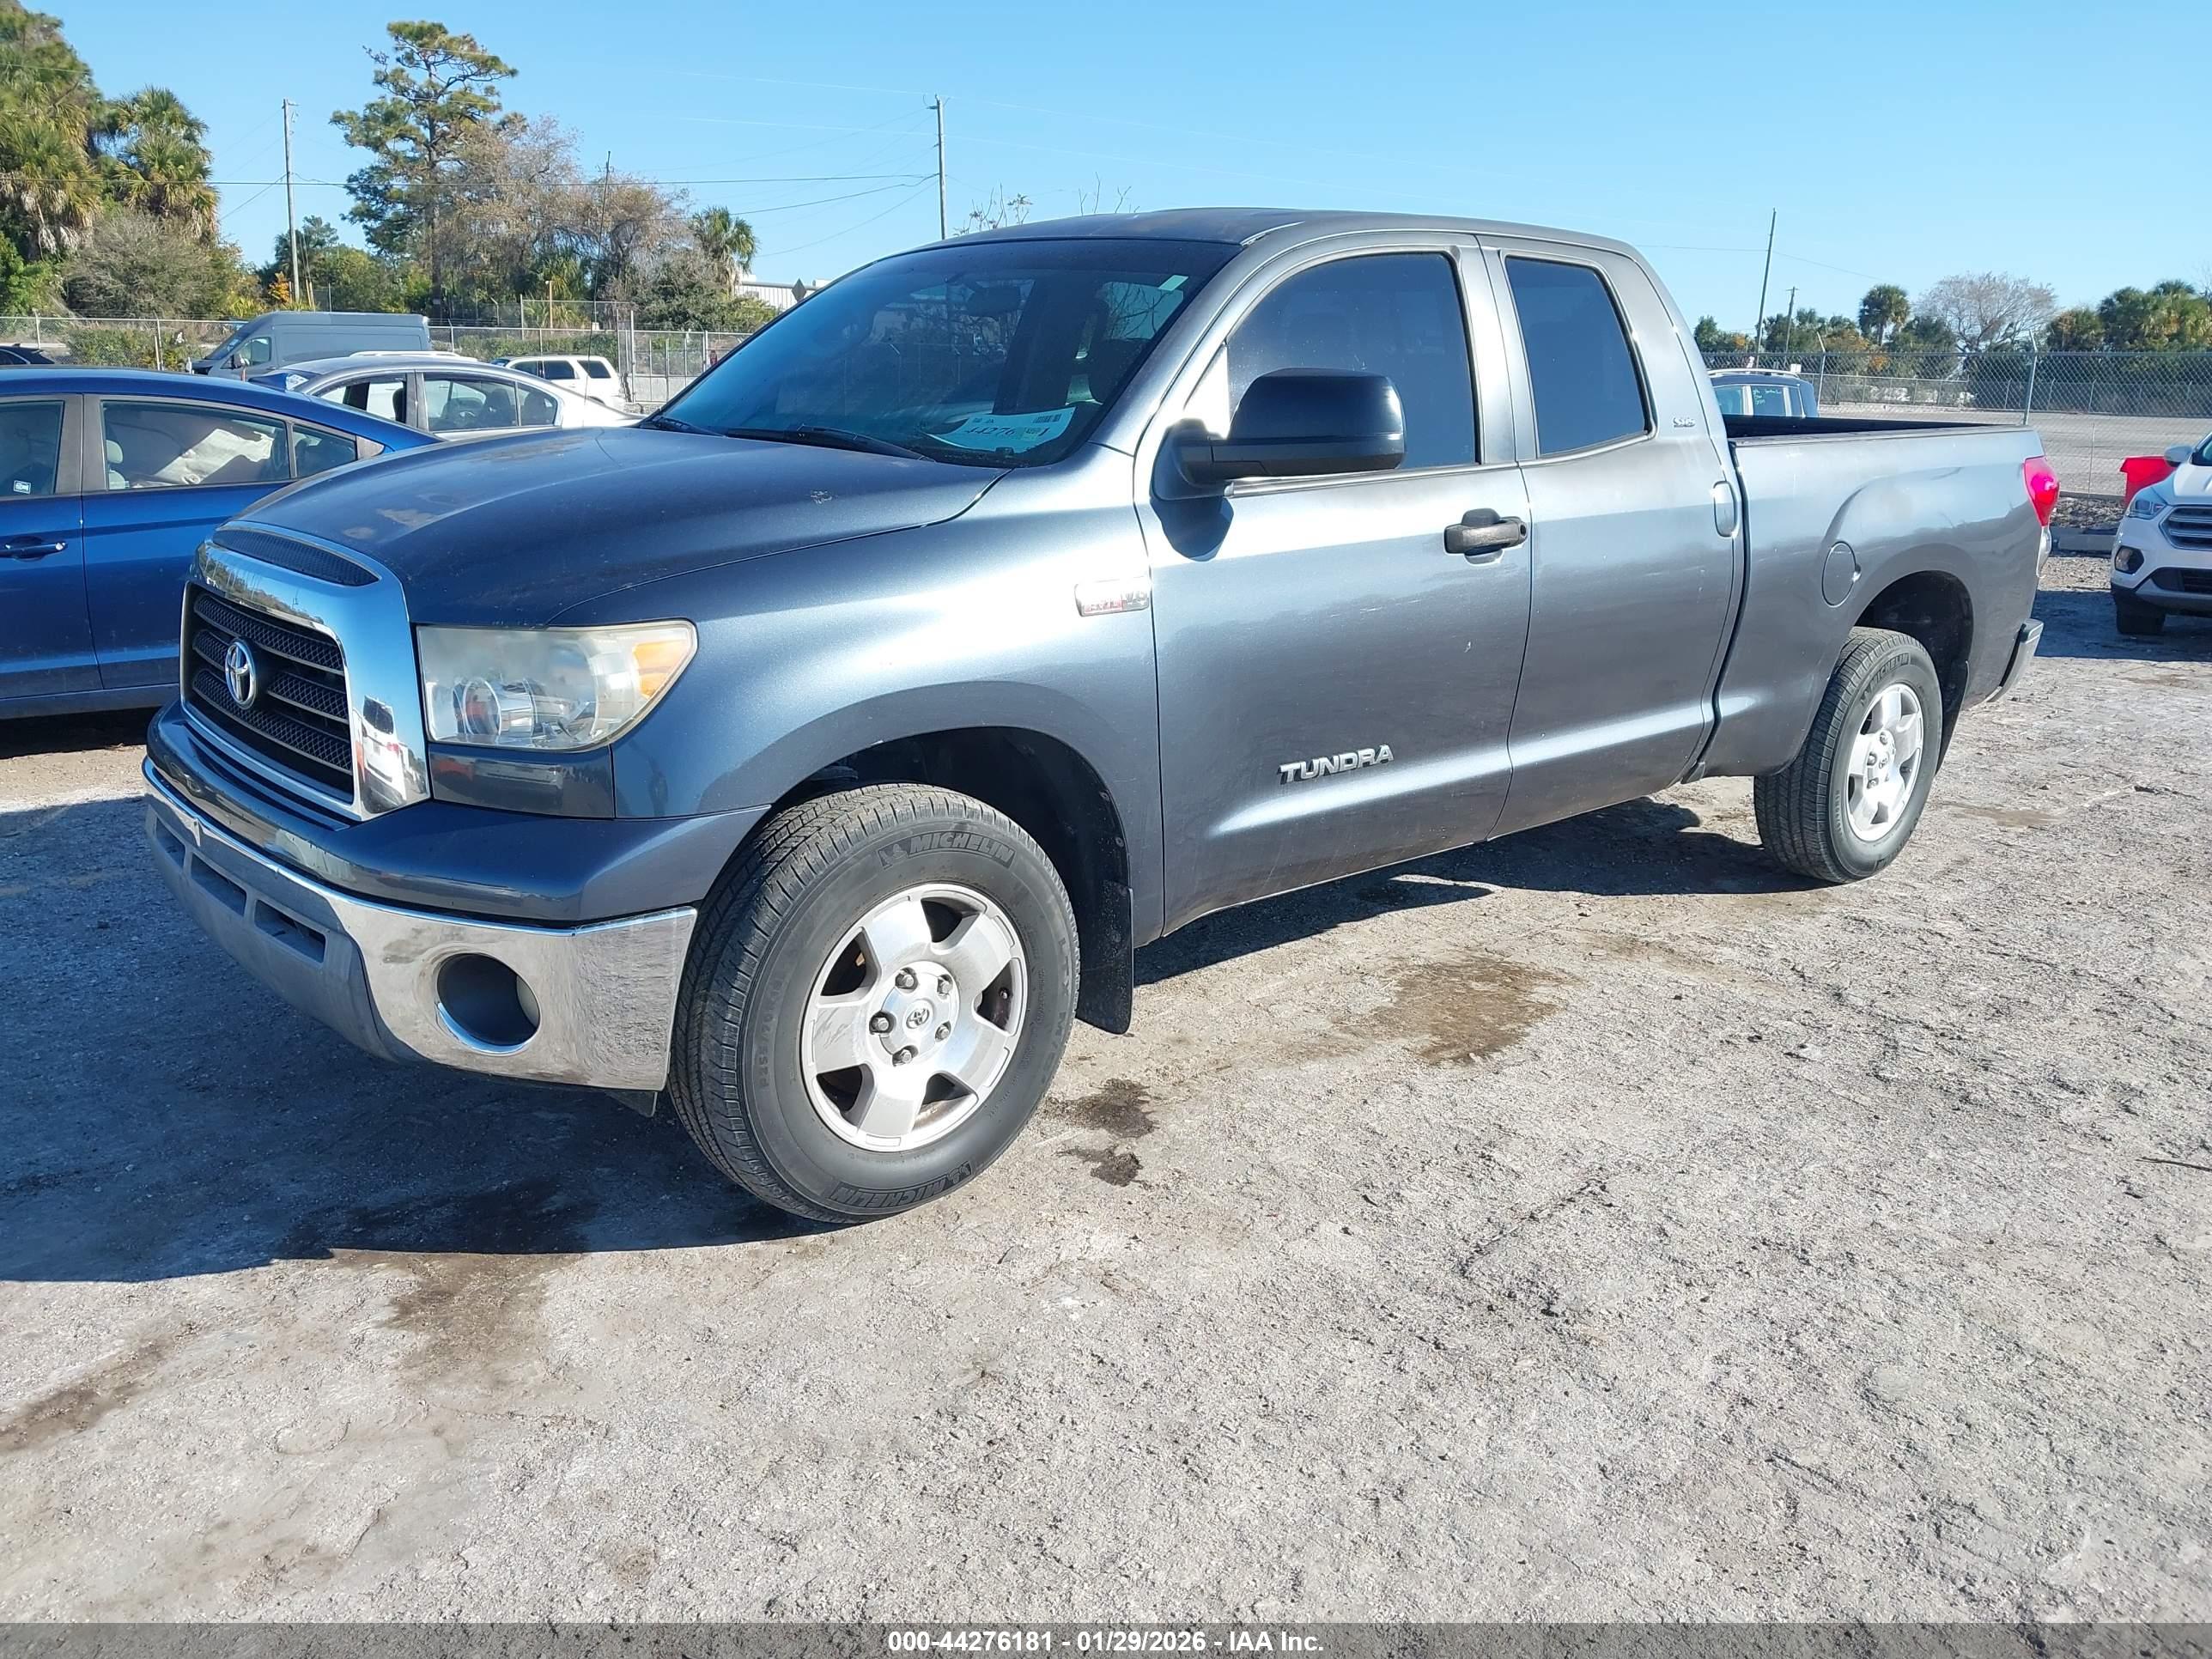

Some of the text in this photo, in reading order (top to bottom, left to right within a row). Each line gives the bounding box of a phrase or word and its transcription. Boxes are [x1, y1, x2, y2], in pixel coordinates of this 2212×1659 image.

[1278, 744, 1395, 785] TUNDRA
[910, 831, 1014, 864] MICHELIN
[830, 1178, 945, 1208] MICHELIN
